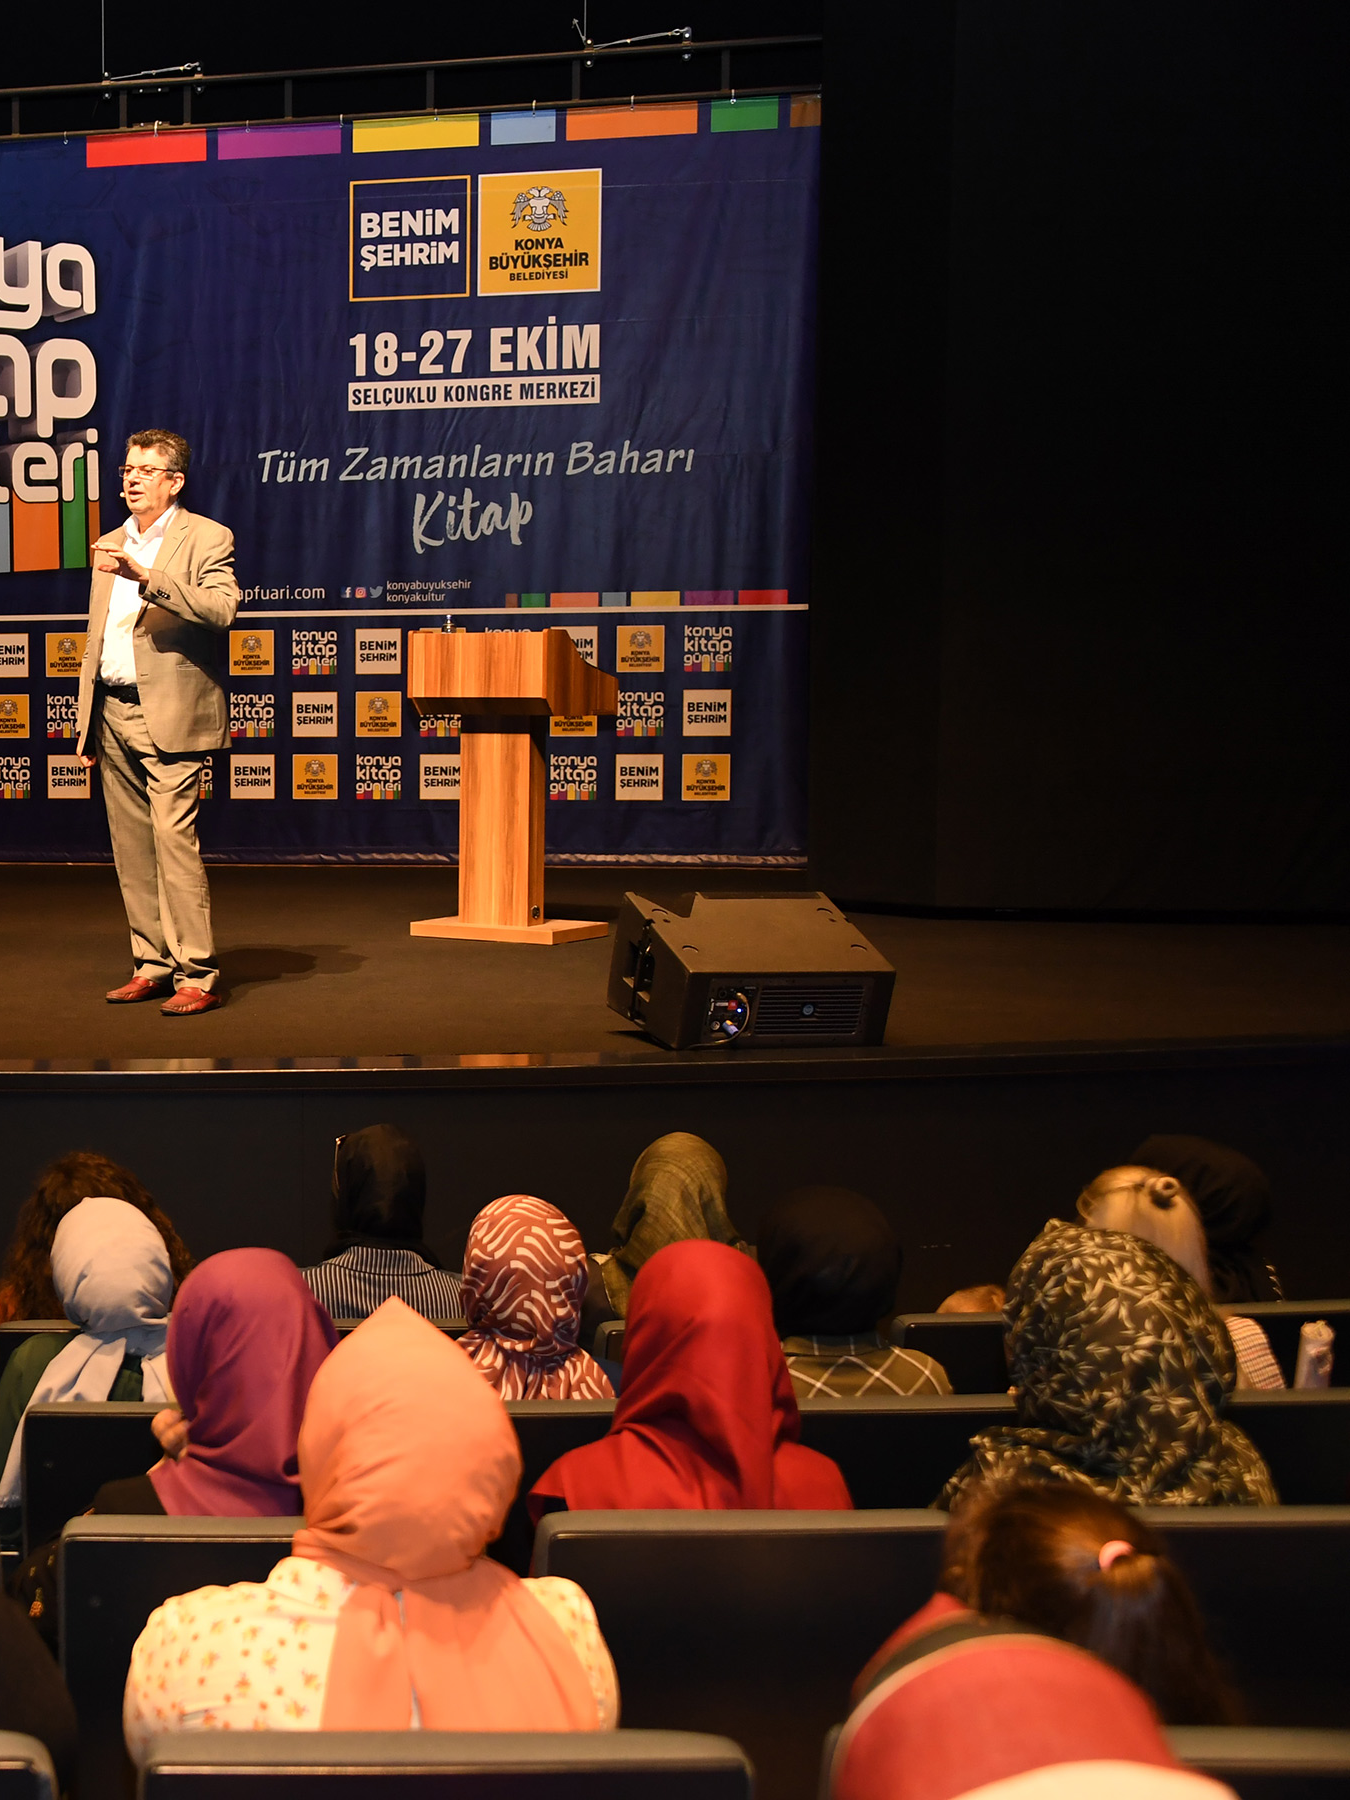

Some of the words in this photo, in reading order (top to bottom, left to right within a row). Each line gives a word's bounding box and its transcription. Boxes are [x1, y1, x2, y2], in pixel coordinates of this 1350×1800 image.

[514, 237, 564, 251] KONYA
[488, 249, 589, 271] BÜYÜKŞEHİR
[509, 269, 568, 282] BELEDİYESİ
[349, 329, 472, 377] 18-27
[490, 315, 600, 372] EKİM
[352, 384, 437, 407] SELÇUKLU
[443, 383, 512, 403] KONGRE
[519, 377, 596, 400] MERKEZİ
[257, 449, 330, 484] Tüm
[338, 444, 554, 482] Zamanların
[566, 439, 695, 477] Baharı
[412, 487, 534, 555] Kitap
[386, 579, 473, 592] konyabuyuksehir
[386, 591, 447, 604] konyakultur
[293, 630, 336, 644] konya
[685, 625, 732, 640] konya
[293, 642, 336, 657] kitap
[685, 638, 731, 654] kitap
[231, 692, 274, 706] konya
[617, 690, 664, 704] konya
[47, 705, 78, 720] kita
[231, 704, 274, 720] kitap
[617, 702, 663, 718] kitap
[420, 718, 461, 731] günler
[357, 754, 400, 768] konya
[551, 754, 596, 768] konya
[357, 766, 400, 782] kitap
[551, 766, 596, 782] kitap
